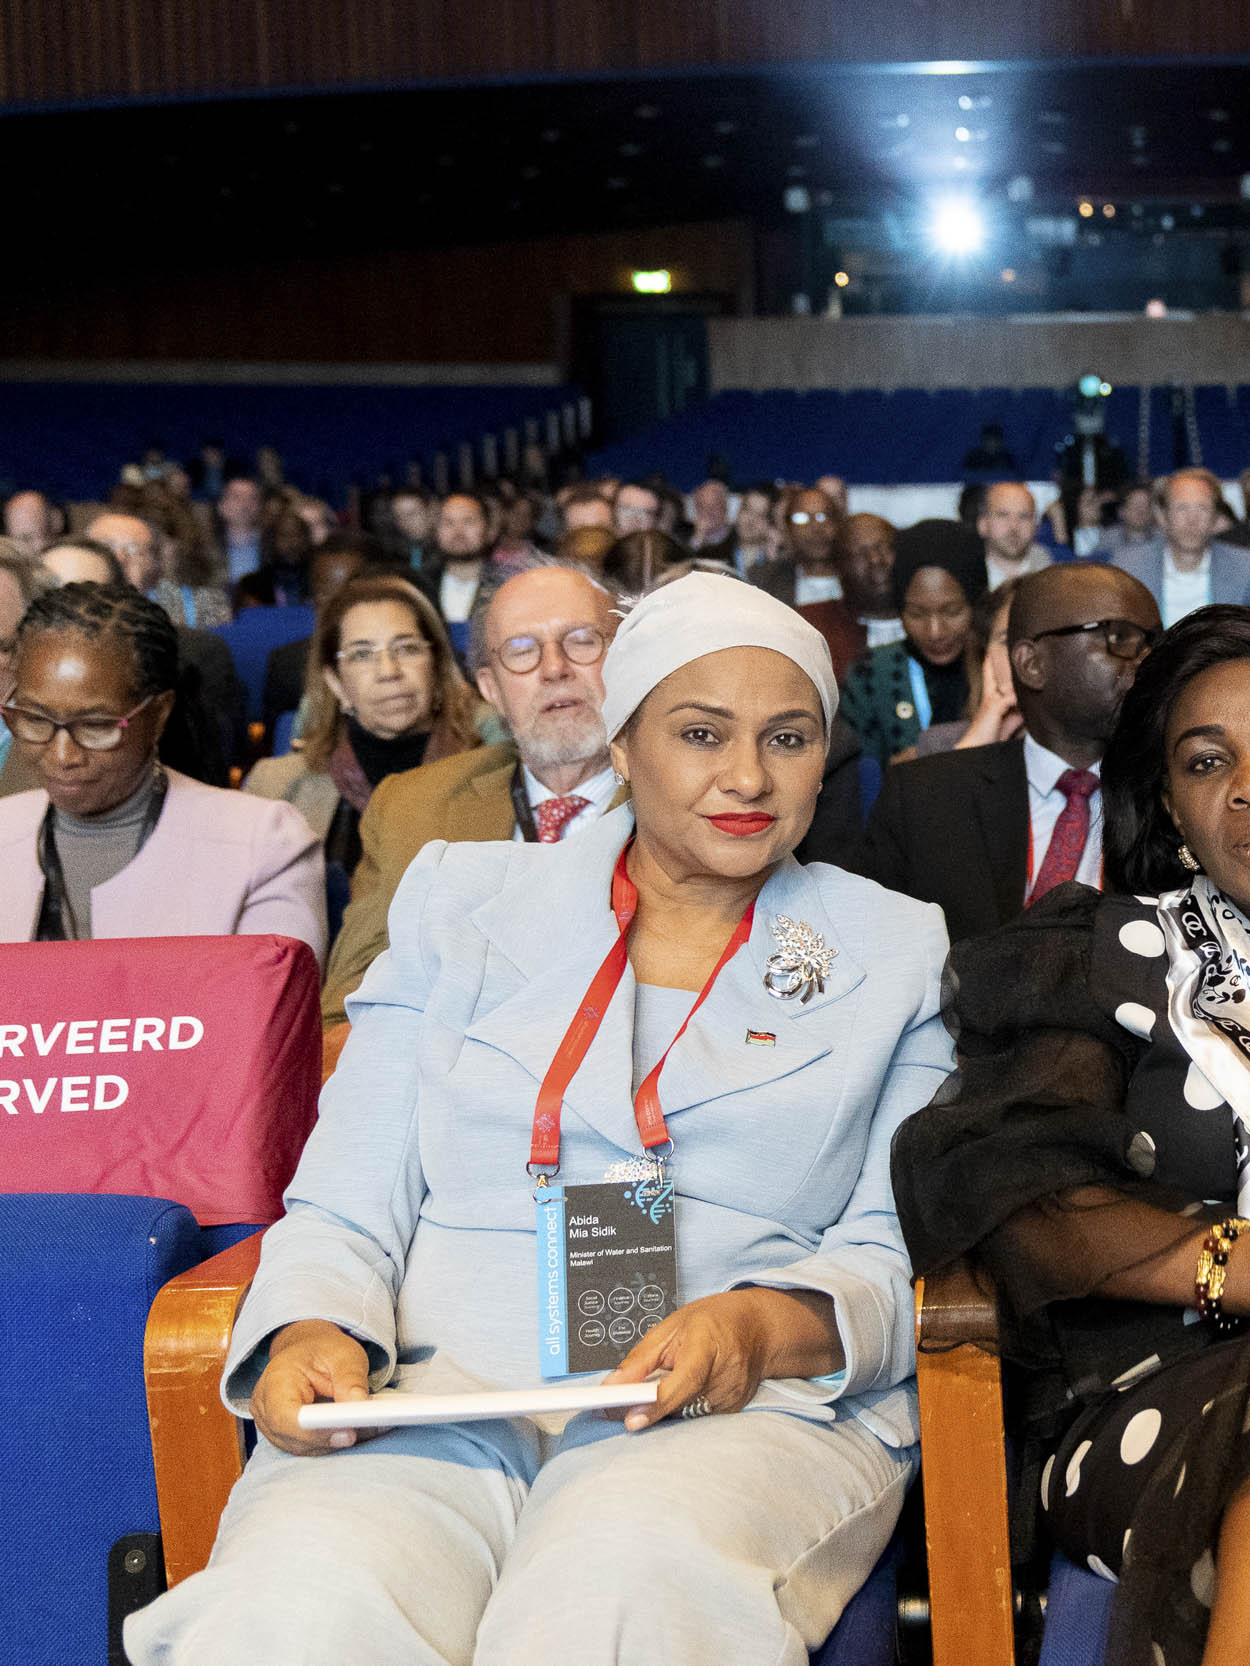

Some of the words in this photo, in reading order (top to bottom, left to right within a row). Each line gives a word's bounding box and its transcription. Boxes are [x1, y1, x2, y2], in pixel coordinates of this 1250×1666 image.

[569, 1215, 599, 1226] Abida
[543, 1206, 559, 1268] connect
[569, 1228, 589, 1239] Mia
[591, 1226, 617, 1237] Sidik
[569, 1251, 596, 1259] Minister
[604, 1248, 625, 1256] Water
[640, 1244, 673, 1254] Sanitation
[569, 1259, 594, 1267] Malawi
[545, 1269, 564, 1335] systems
[546, 1337, 560, 1355] all
